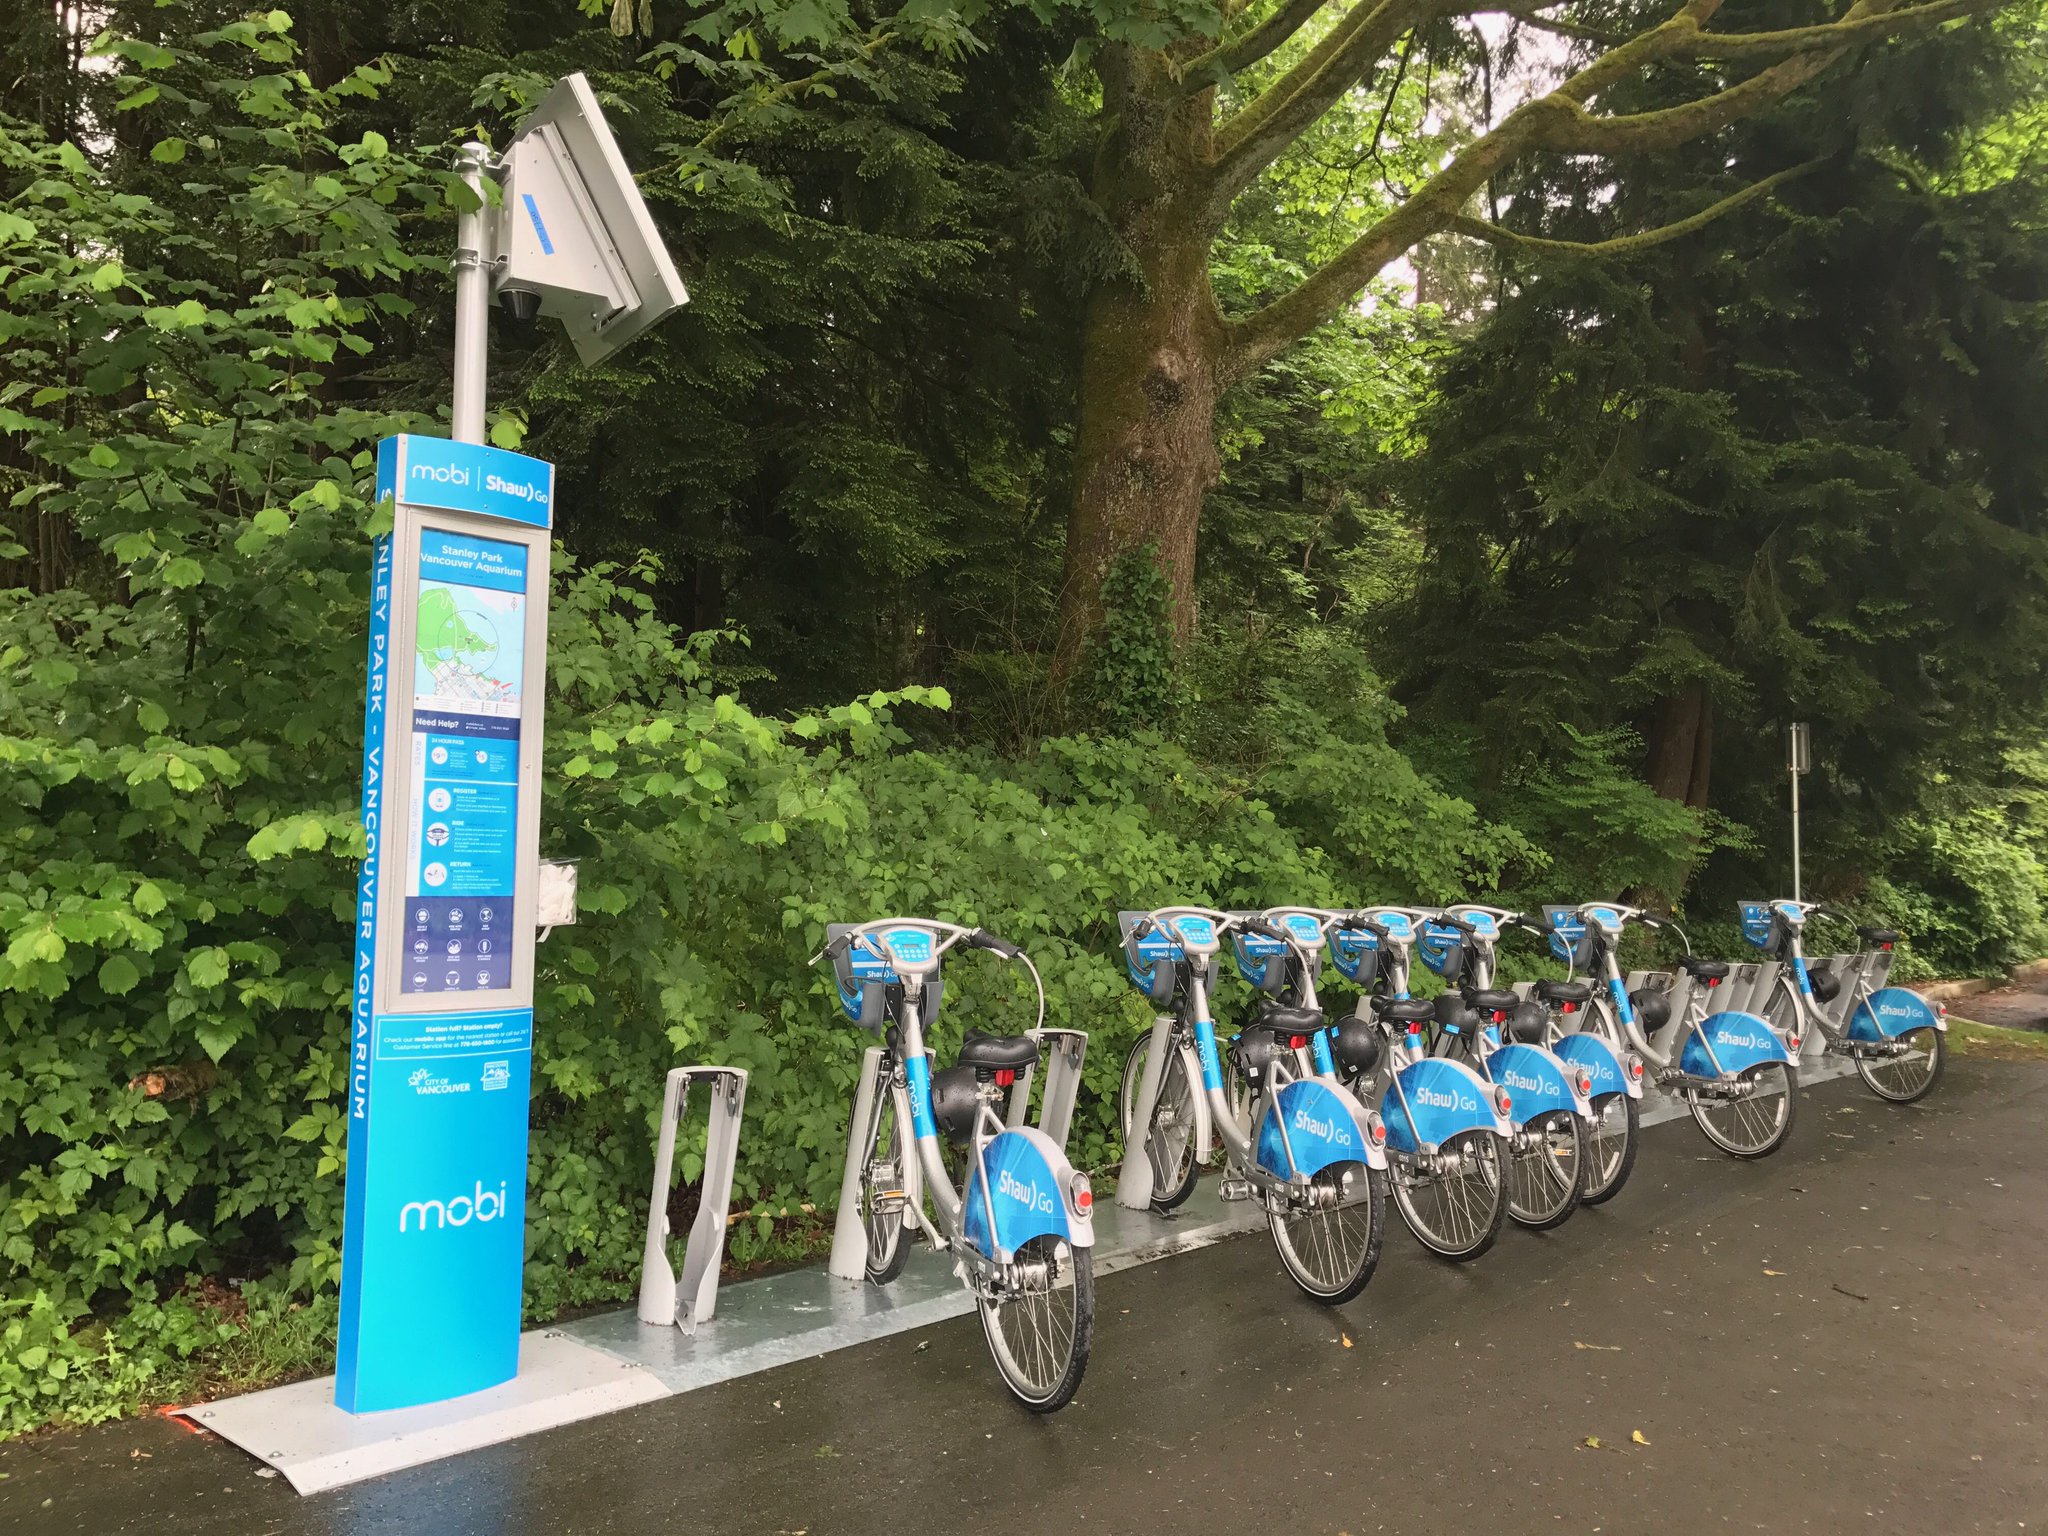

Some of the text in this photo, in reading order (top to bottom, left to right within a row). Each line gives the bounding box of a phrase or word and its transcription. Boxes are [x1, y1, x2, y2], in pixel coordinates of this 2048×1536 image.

[412, 463, 470, 486] mobi
[535, 490, 549, 504] Go
[374, 487, 392, 622] SNLEY
[441, 545, 504, 564] Stanley Park
[420, 553, 523, 578] Vancouver Aquarium
[366, 634, 385, 713] PARK
[415, 717, 437, 727] Need
[438, 719, 460, 730] Help?
[361, 746, 381, 940] VANCOUVER
[1613, 991, 1624, 1013] mobi
[1911, 1009, 1924, 1018] Go
[353, 951, 371, 1120] AQUARIUM
[1756, 1038, 1771, 1049] Go
[1197, 1040, 1210, 1072] mobi
[425, 1077, 449, 1086] CITY OF
[1600, 1066, 1614, 1080] Go
[416, 1083, 471, 1095] VANCOUVER
[907, 1079, 922, 1118] mobi
[1545, 1082, 1561, 1097] Go
[1460, 1098, 1477, 1112] Go
[1335, 1129, 1351, 1146] Go
[399, 1180, 507, 1233] mobi
[1038, 1192, 1054, 1214] Go
